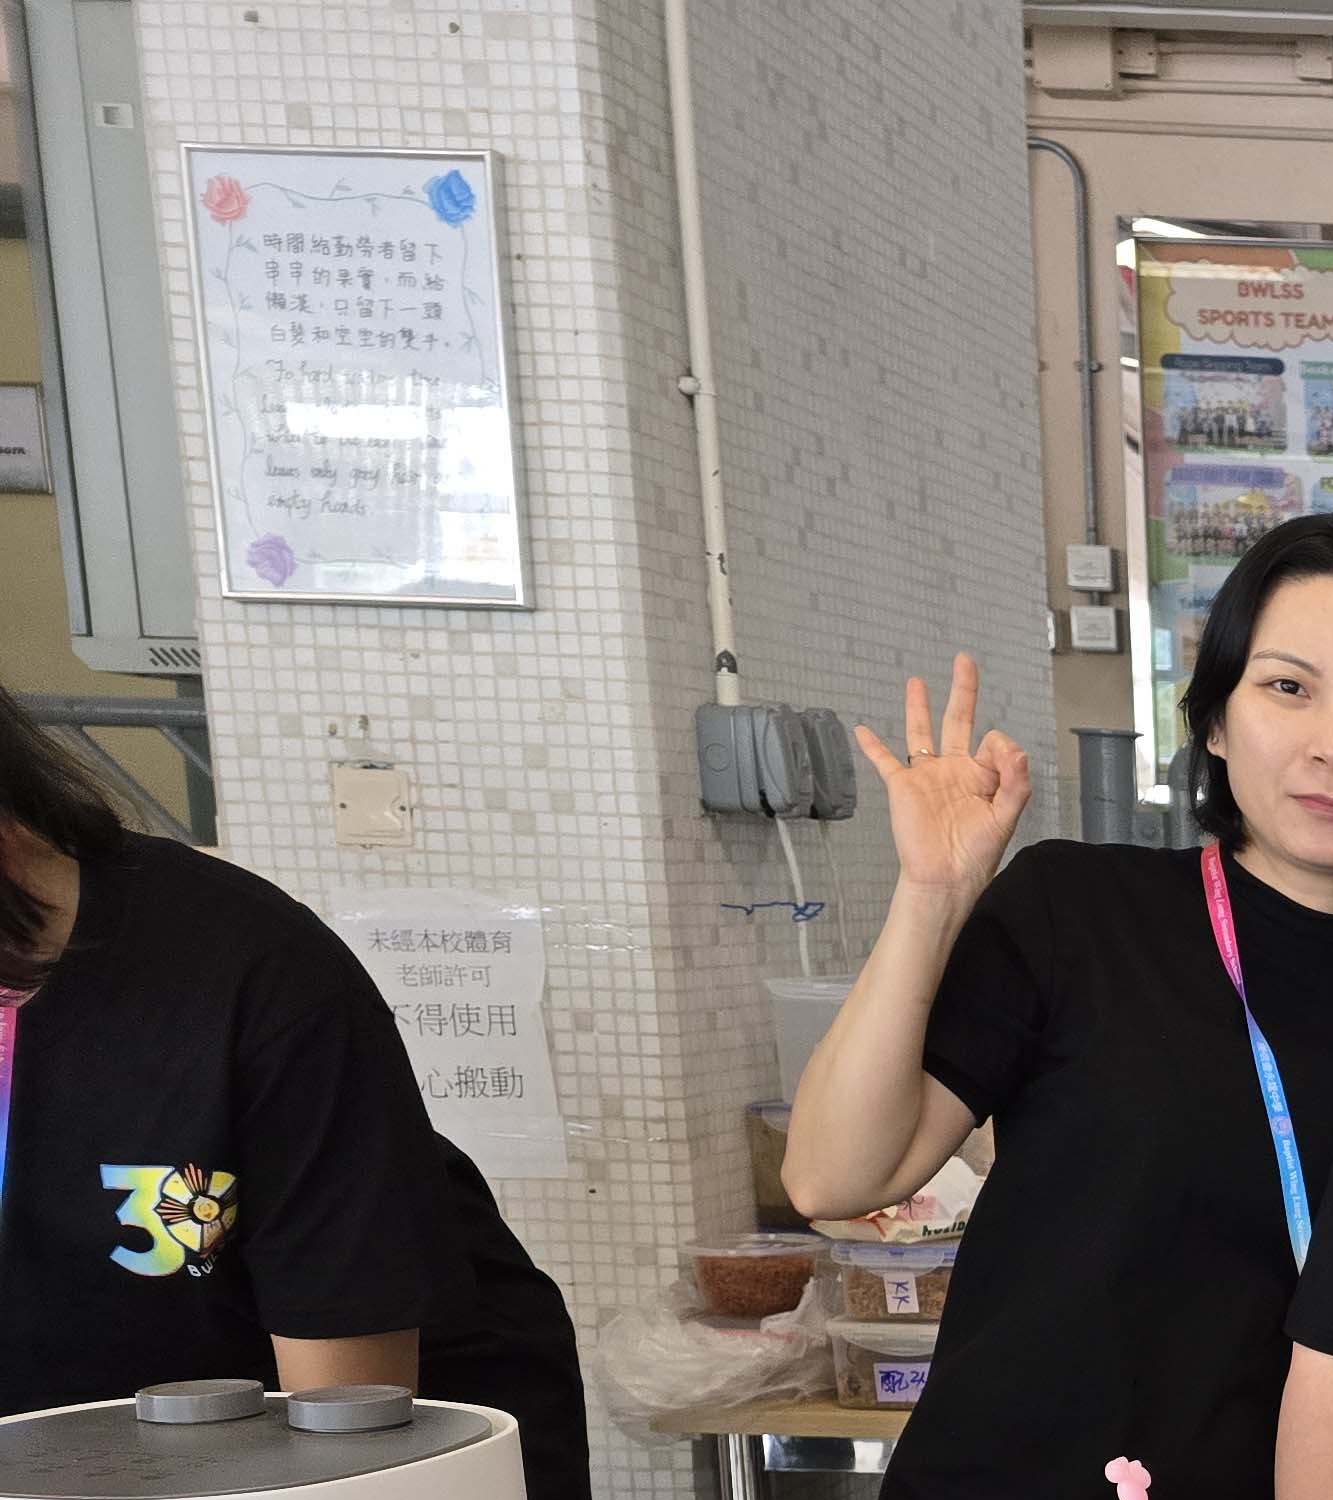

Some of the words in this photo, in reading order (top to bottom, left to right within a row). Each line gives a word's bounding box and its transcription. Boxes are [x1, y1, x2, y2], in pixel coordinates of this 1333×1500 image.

[1237, 280, 1305, 301] BWLSS
[1197, 308, 1272, 329] SPORTS
[367, 929, 513, 955] 未經本校體育
[395, 964, 491, 989] 老師許可
[420, 1065, 524, 1100] 心搬動
